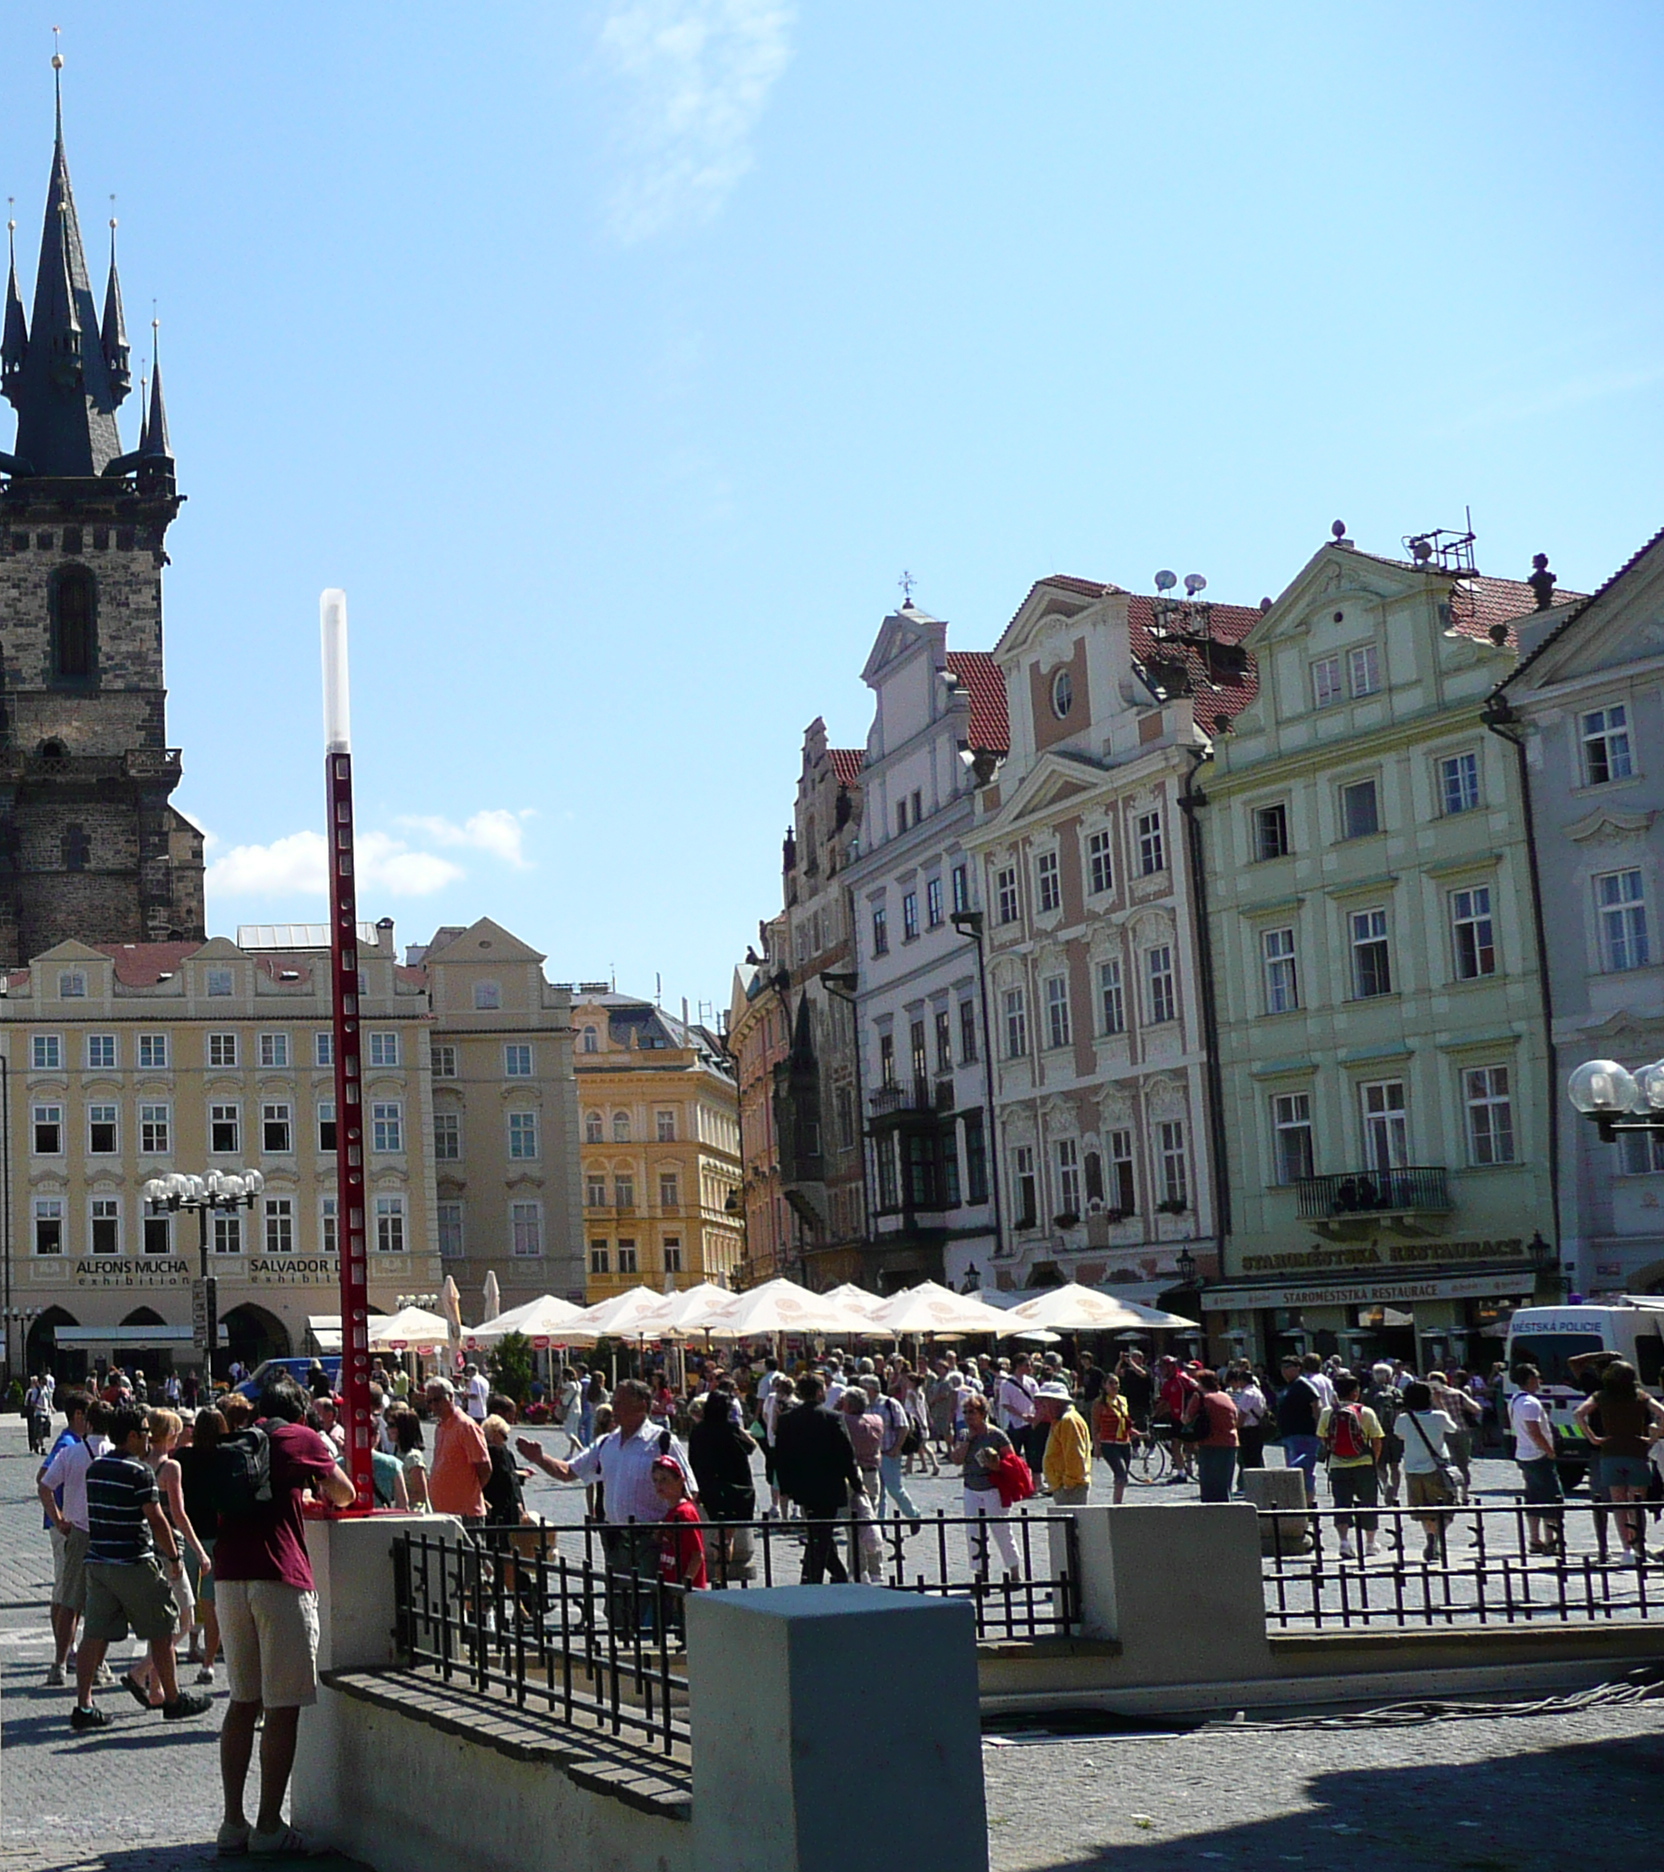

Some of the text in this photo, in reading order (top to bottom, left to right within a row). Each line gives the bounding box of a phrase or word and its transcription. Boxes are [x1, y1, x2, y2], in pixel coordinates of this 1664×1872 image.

[1389, 1238, 1524, 1262] RESTAURACE
[76, 1260, 189, 1274] ALFONS MUCHA
[250, 1259, 329, 1272] SALVADOR
[78, 1275, 190, 1286] exhibition
[1560, 1321, 1602, 1332] POLICIE
